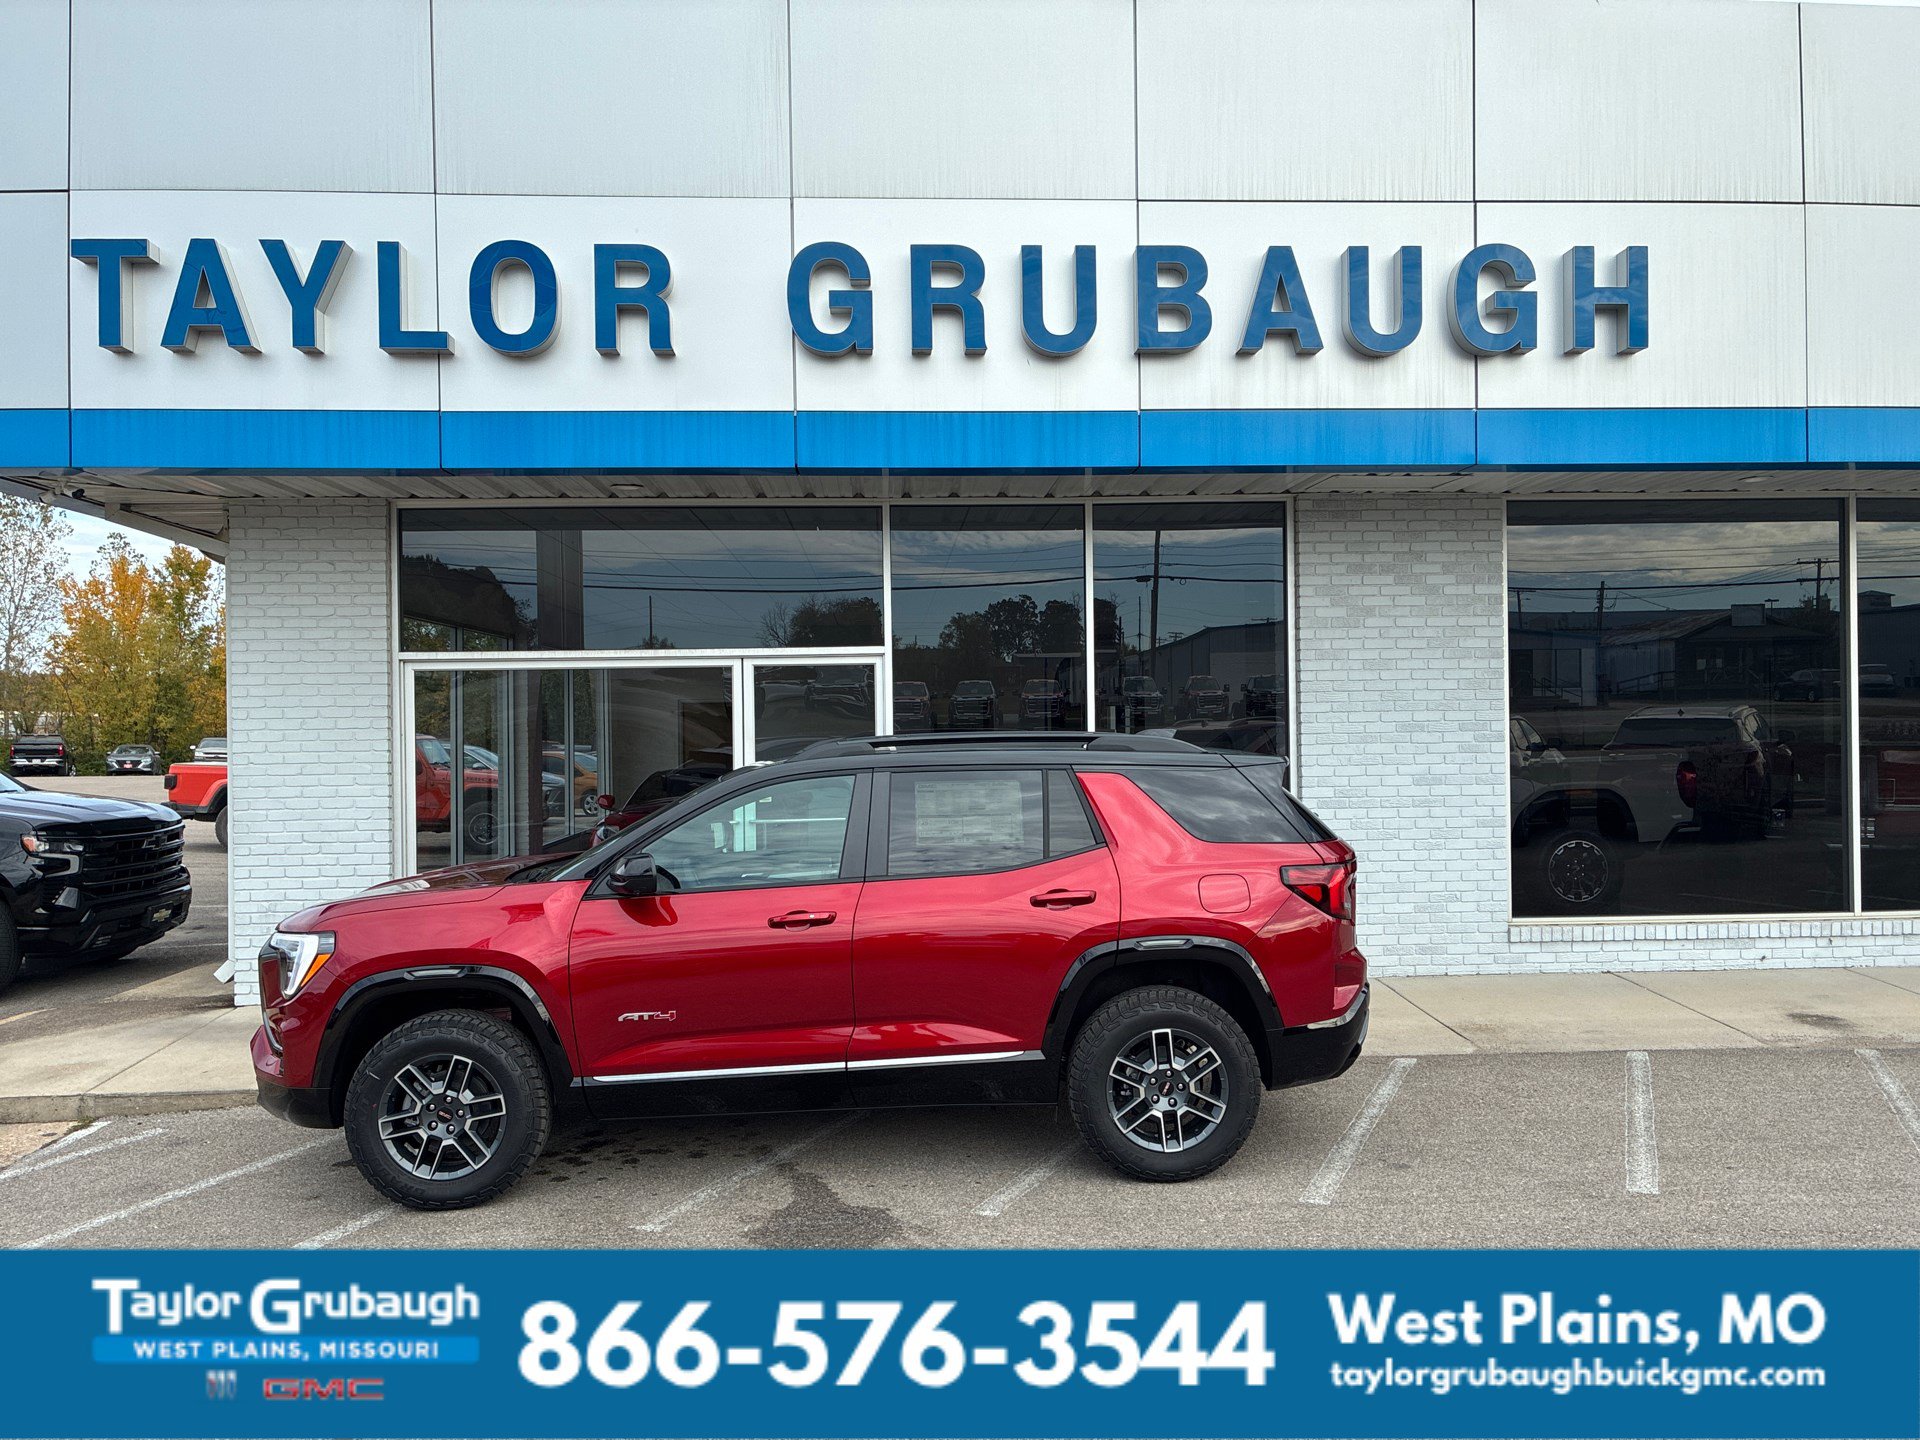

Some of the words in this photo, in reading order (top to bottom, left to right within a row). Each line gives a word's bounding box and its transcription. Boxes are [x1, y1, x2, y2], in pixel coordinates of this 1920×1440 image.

[70, 237, 676, 358] TAYLOR
[787, 240, 1650, 358] GRUBAUGH
[617, 1010, 677, 1022] AT4
